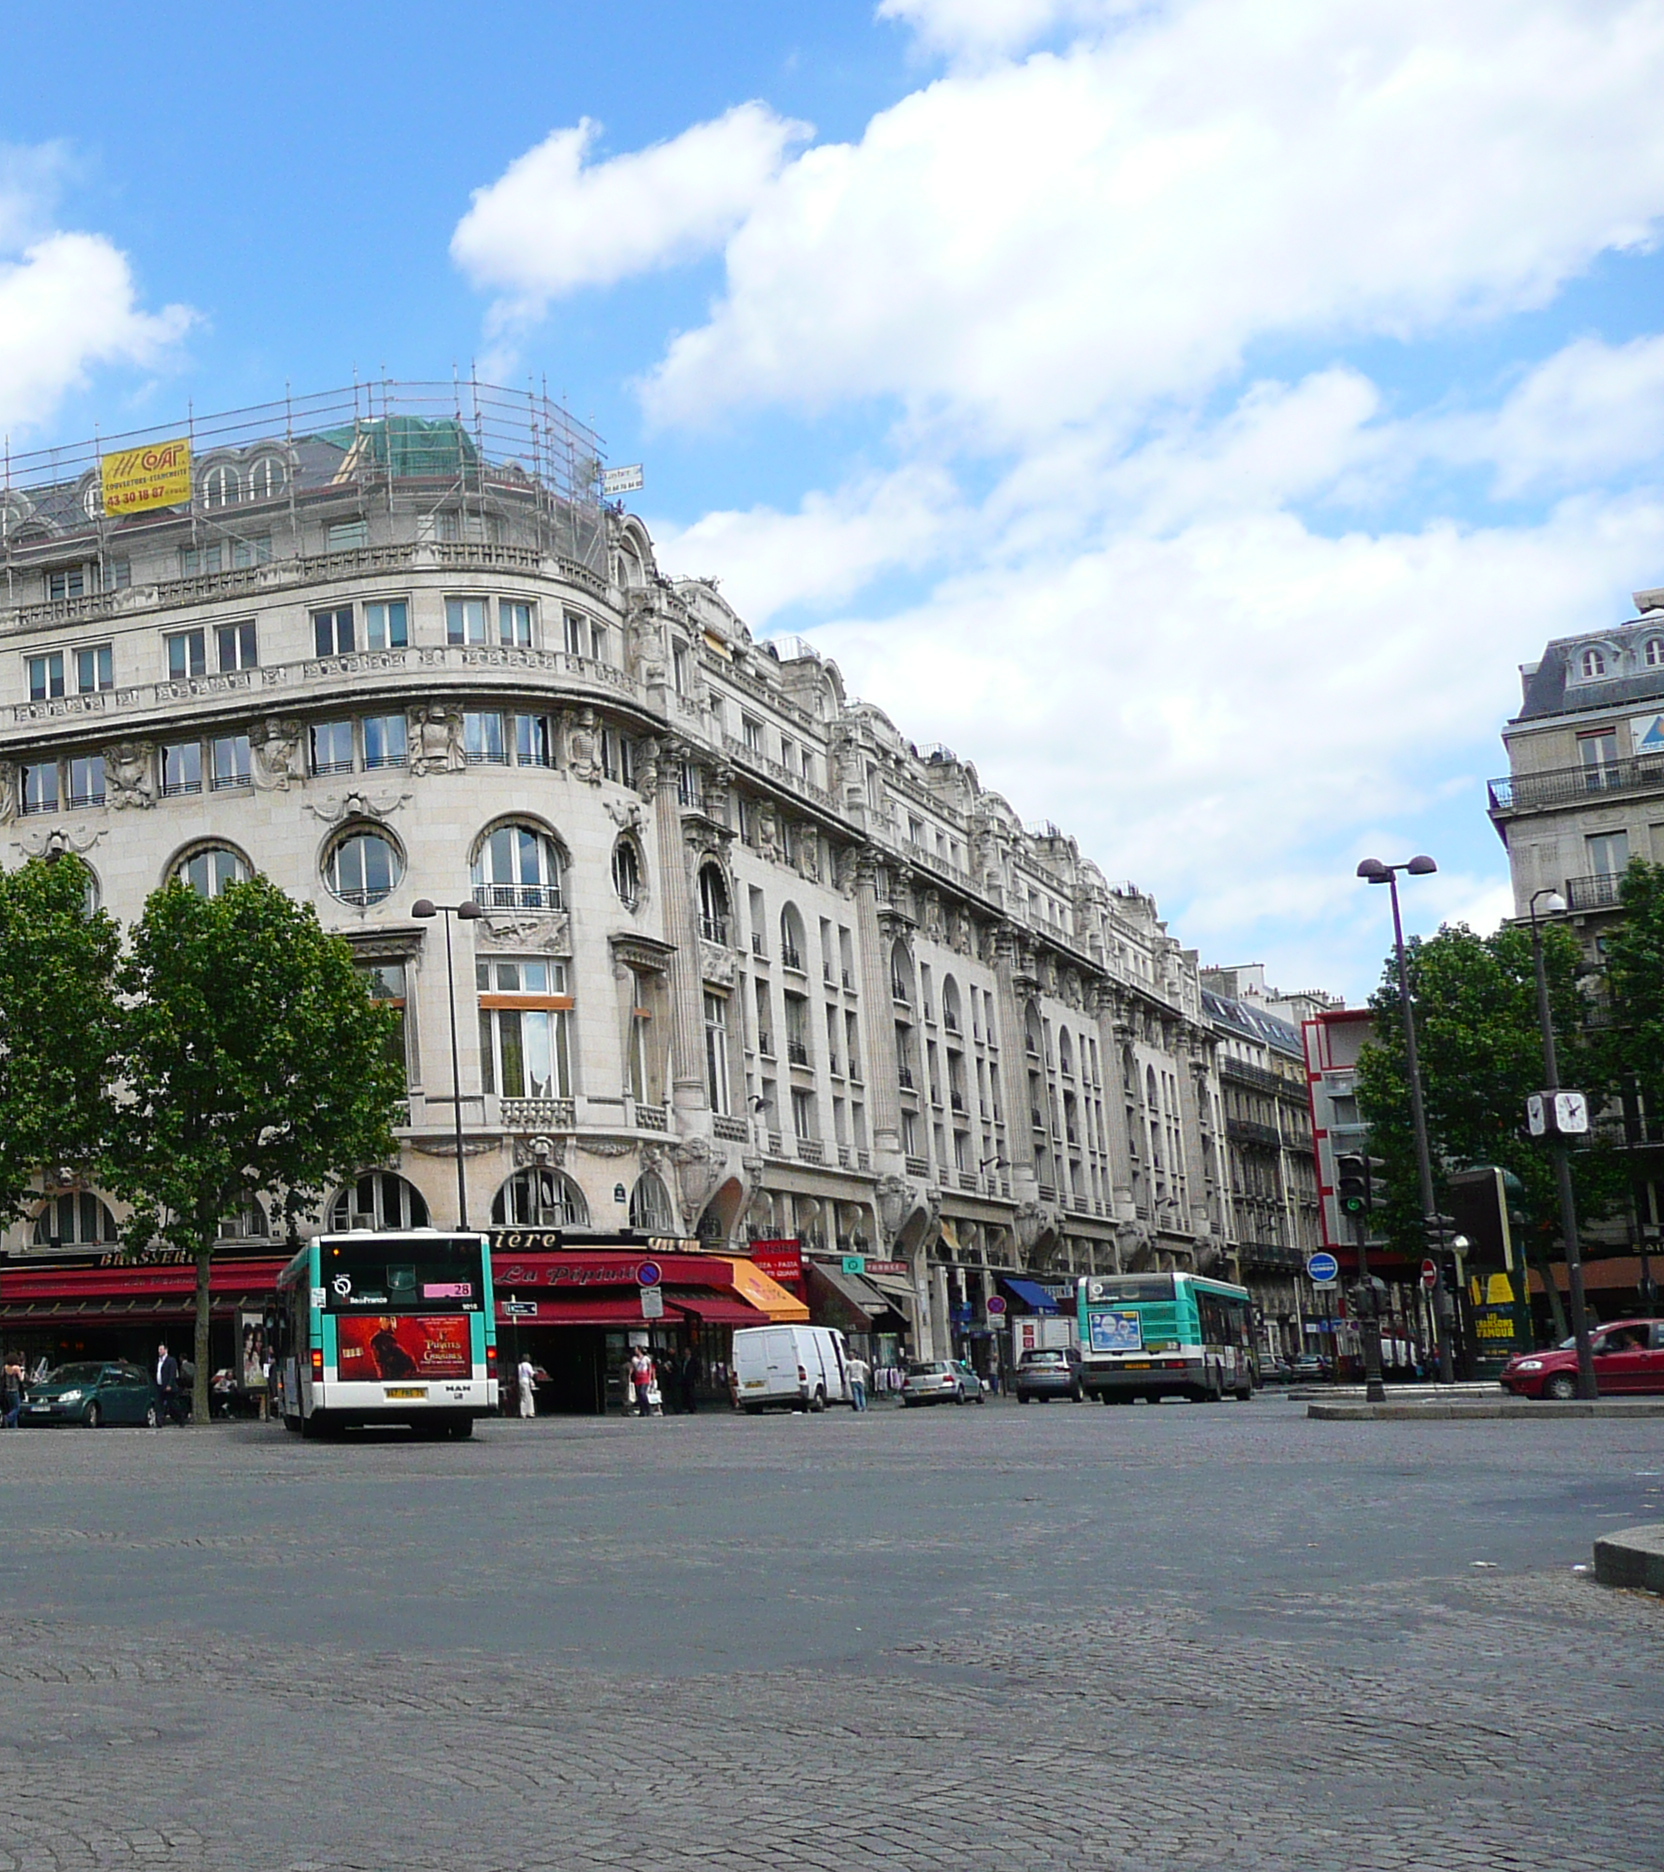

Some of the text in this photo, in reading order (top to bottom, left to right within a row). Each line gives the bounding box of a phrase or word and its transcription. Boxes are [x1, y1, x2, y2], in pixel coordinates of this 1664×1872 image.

[107, 495, 120, 506] 43
[123, 491, 136, 504] 30
[138, 489, 149, 501] 18
[152, 485, 165, 498] 87
[494, 1266, 537, 1284] La
[454, 1285, 469, 1295] 28
